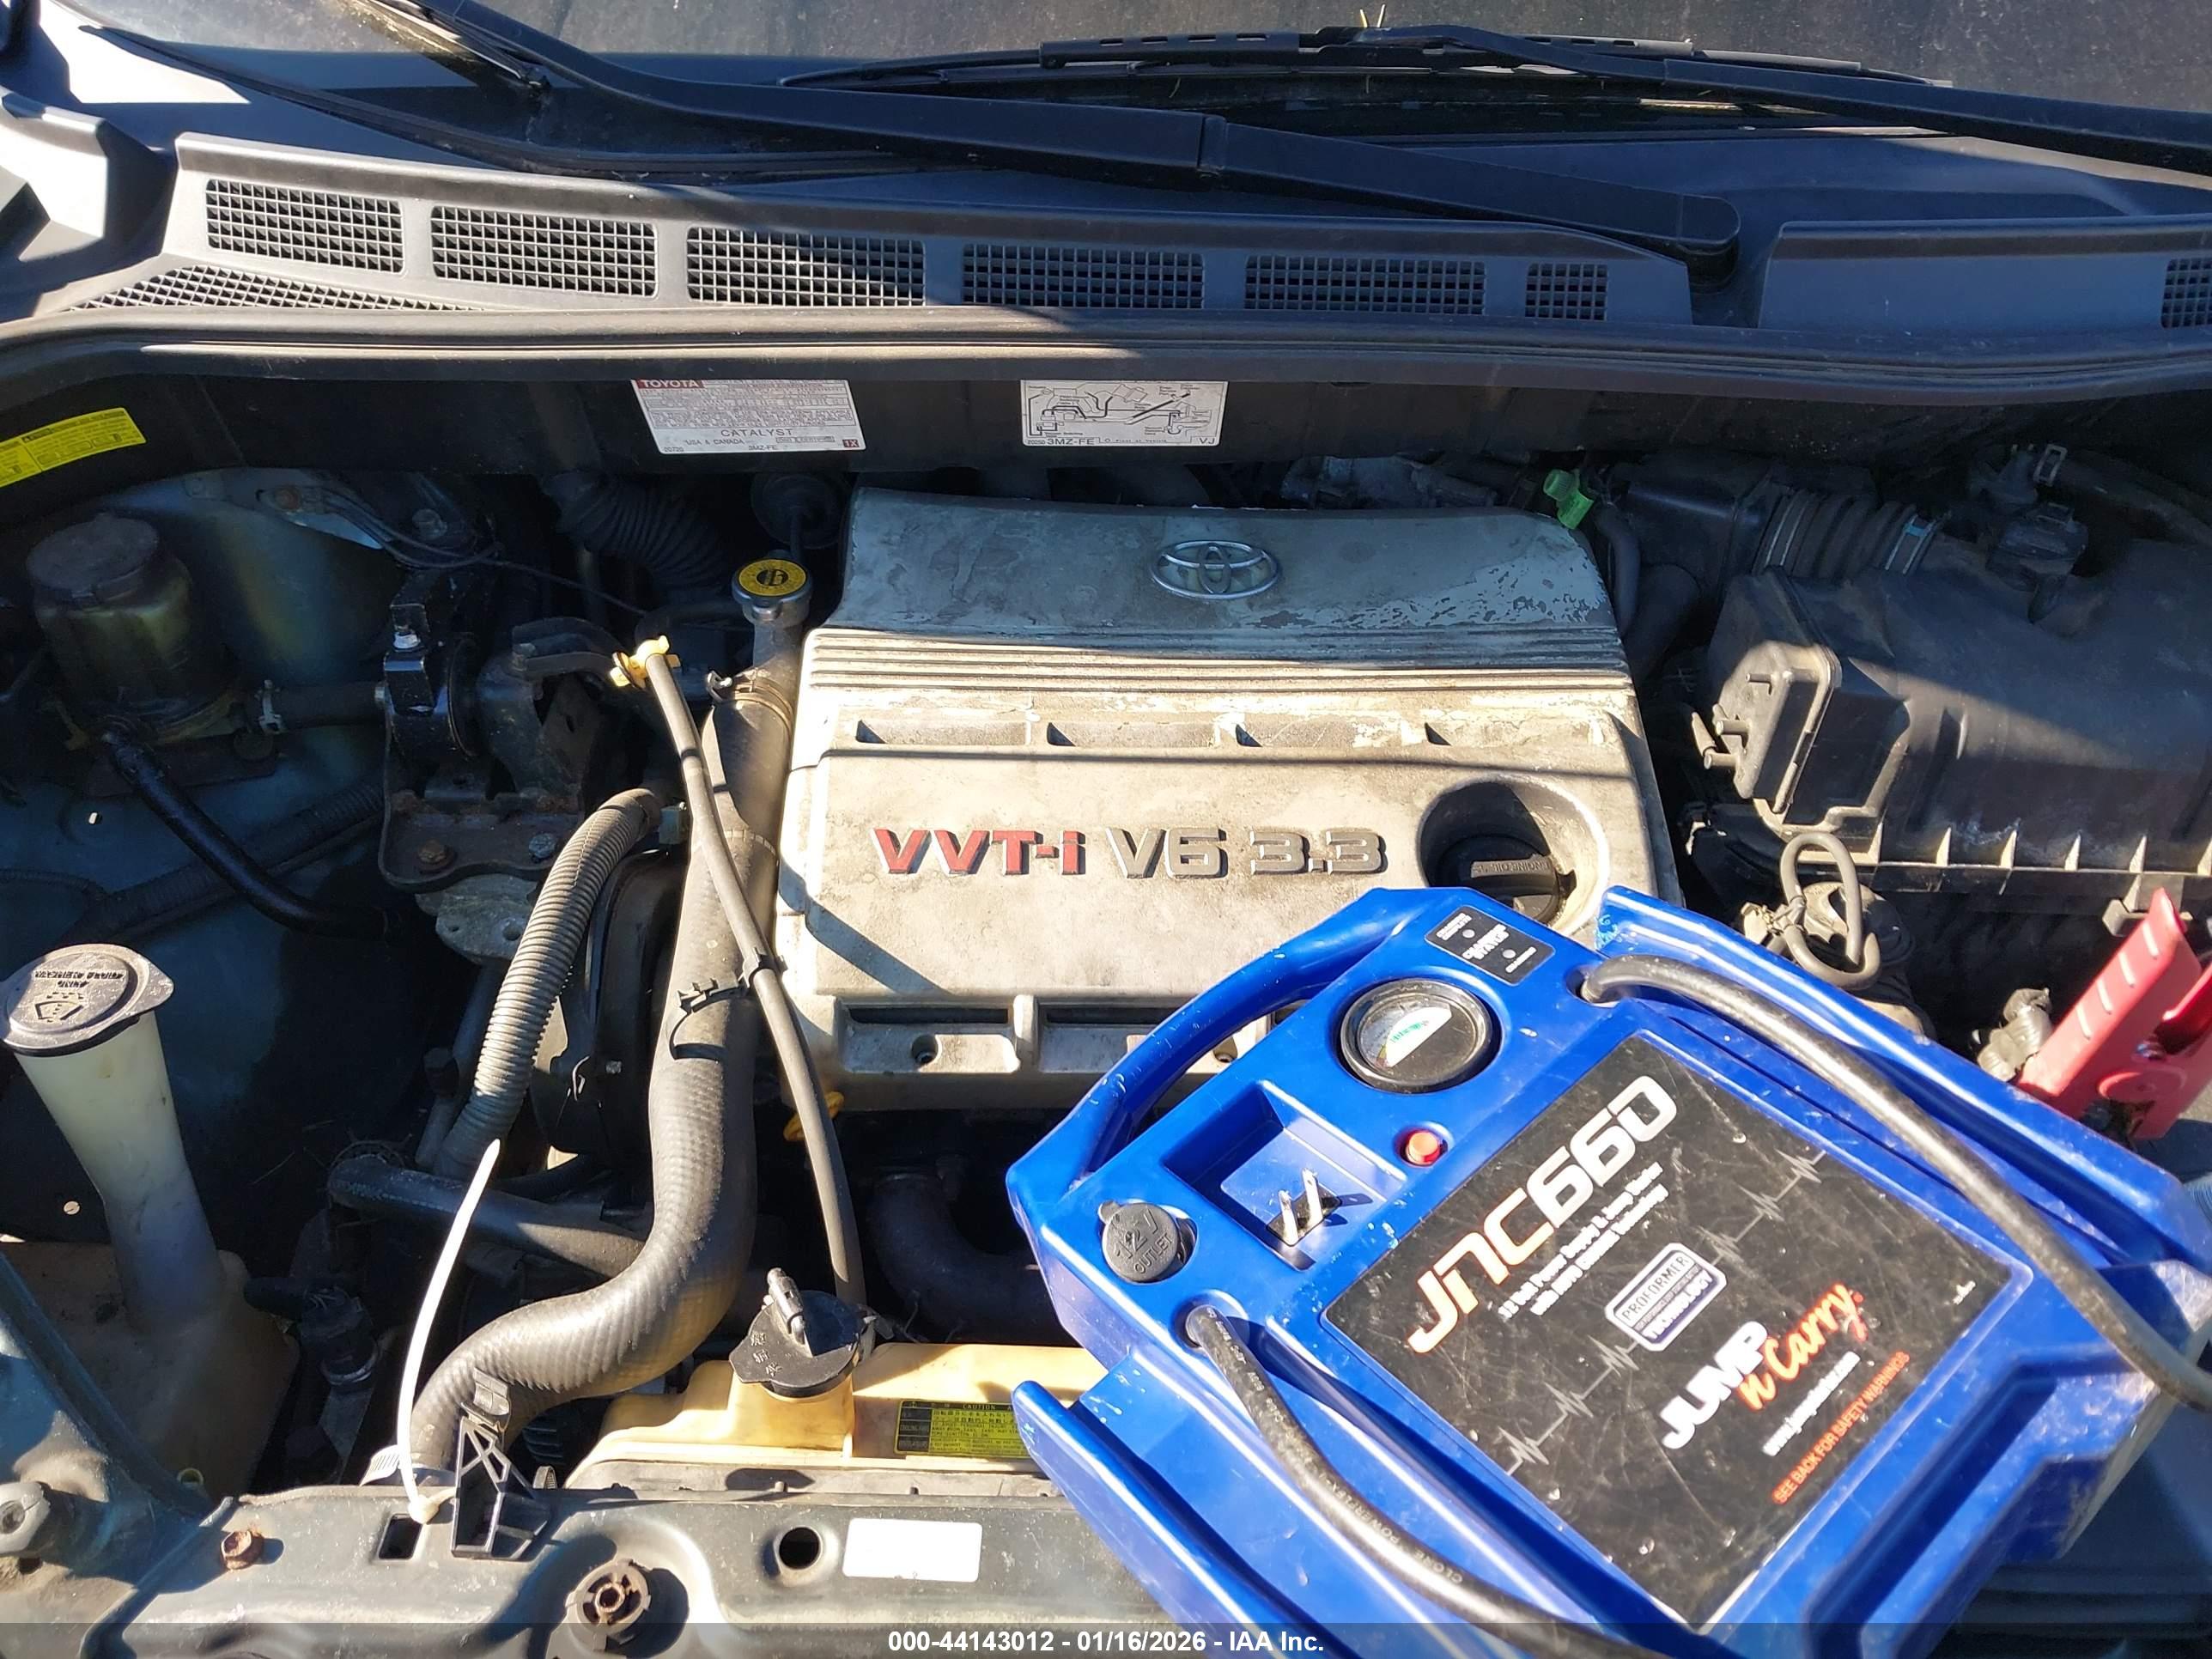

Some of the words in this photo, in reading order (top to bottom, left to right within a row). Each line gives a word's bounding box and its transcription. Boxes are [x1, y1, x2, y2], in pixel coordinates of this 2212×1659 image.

[640, 380, 699, 388] TOYOTA
[870, 829, 1085, 876] VVT-i
[1106, 828, 1226, 878] V6
[1250, 830, 1385, 876] 3.3
[1134, 1232, 1172, 1274] OUTLET
[1621, 1256, 1689, 1321] PROFORMER
[1660, 1321, 1767, 1449] JUMP
[1772, 1479, 1799, 1504] SEE
[1790, 1454, 1821, 1485] BACK
[1814, 1432, 1839, 1457] FOR
[1831, 1397, 1868, 1437] SAFETY
[1862, 1351, 1911, 1401] WARNINGS
